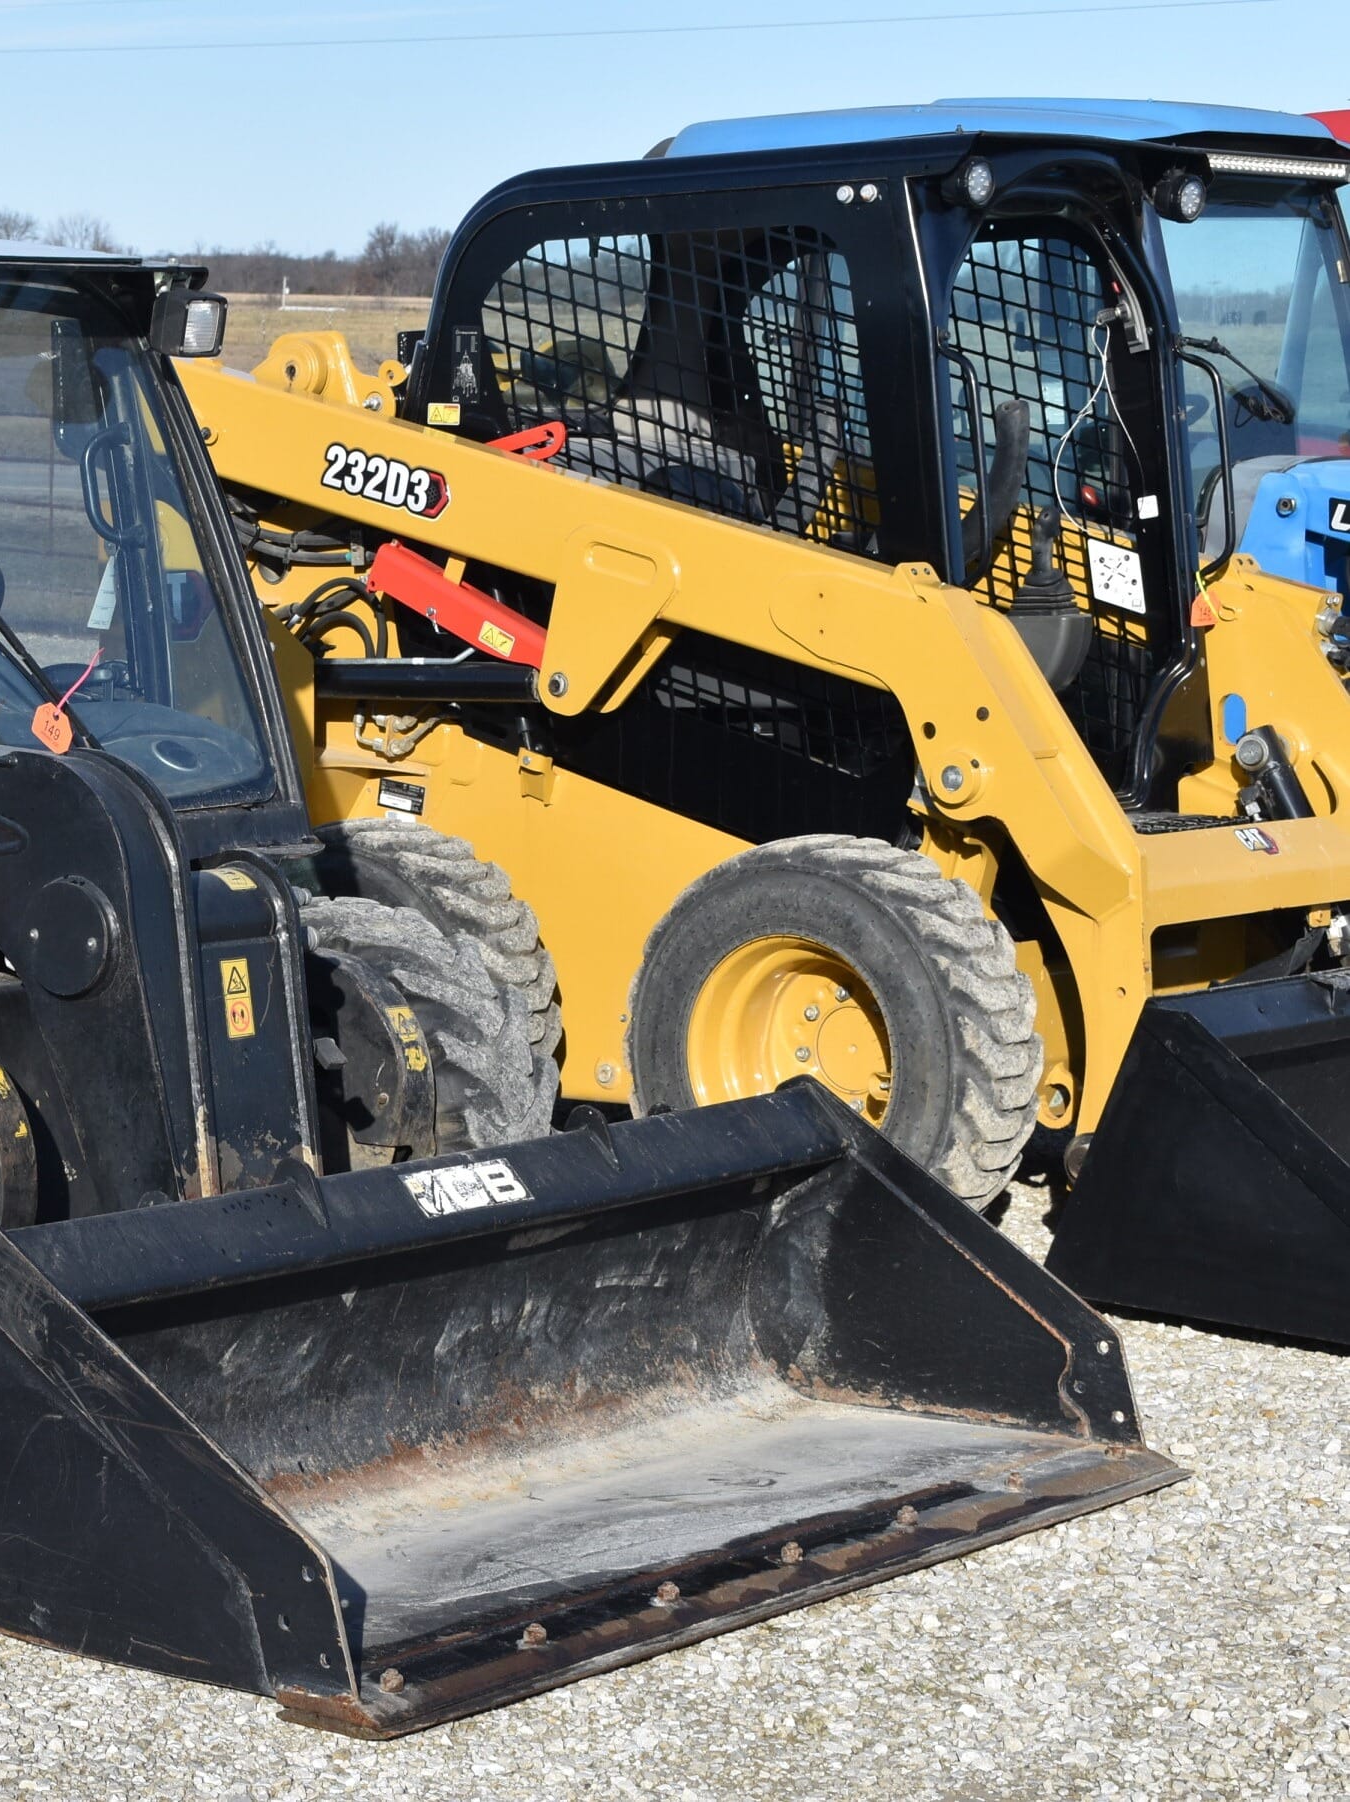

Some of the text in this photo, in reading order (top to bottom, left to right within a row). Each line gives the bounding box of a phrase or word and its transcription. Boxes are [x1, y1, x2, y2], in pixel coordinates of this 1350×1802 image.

[322, 443, 431, 513] 232D3
[44, 719, 61, 741] 149
[1234, 828, 1270, 851] CAT
